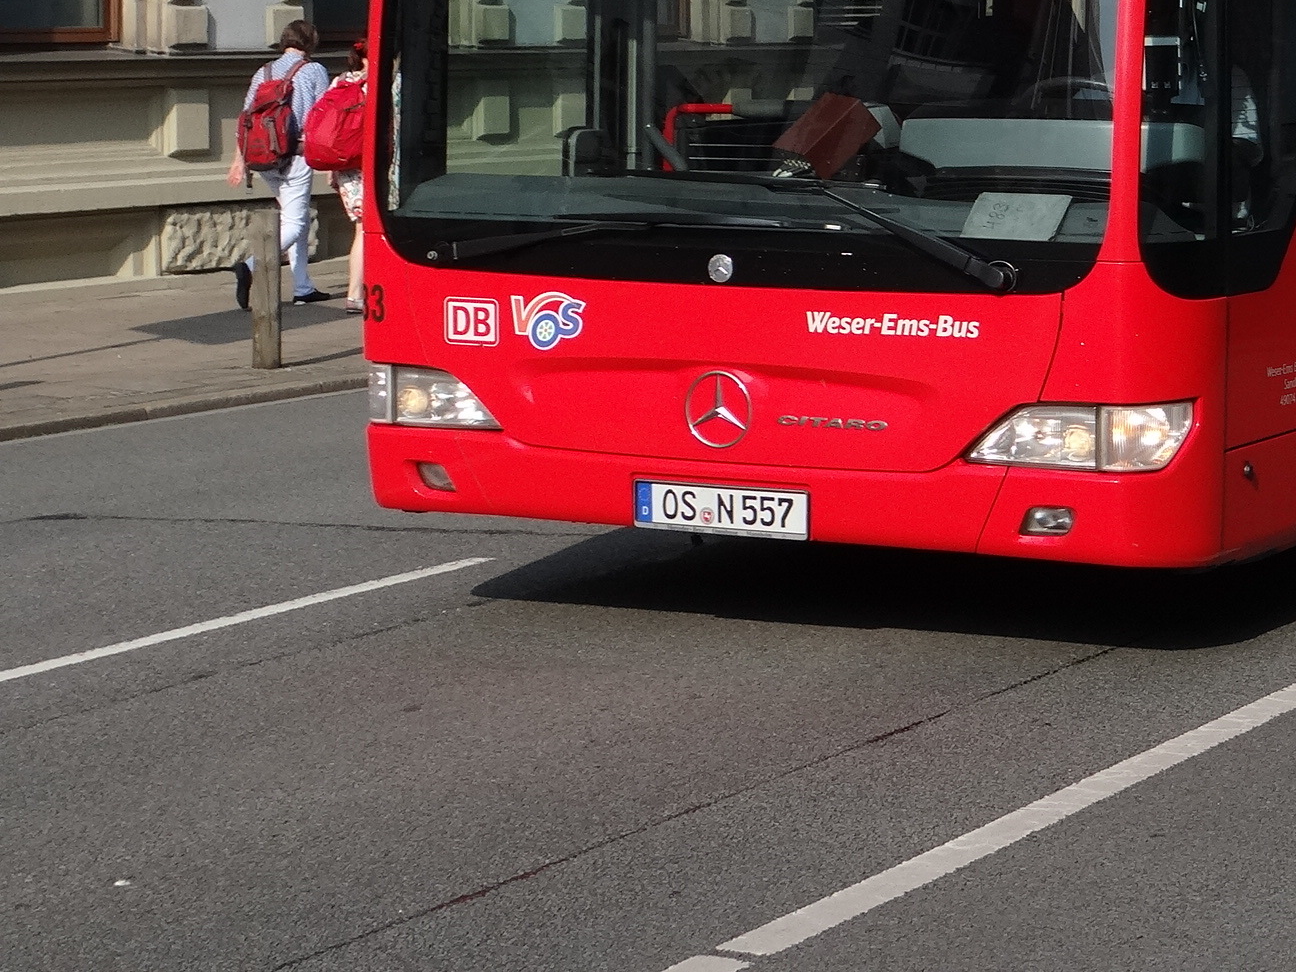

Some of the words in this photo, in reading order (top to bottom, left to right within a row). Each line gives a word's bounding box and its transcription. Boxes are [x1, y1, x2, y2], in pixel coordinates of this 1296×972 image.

[451, 305, 492, 338] DB
[805, 310, 980, 339] Weser-Ems-Bus
[777, 414, 889, 432] CITARO
[641, 506, 650, 516] D
[662, 488, 697, 521] OS
[717, 493, 735, 524] N
[741, 494, 794, 528] 557
